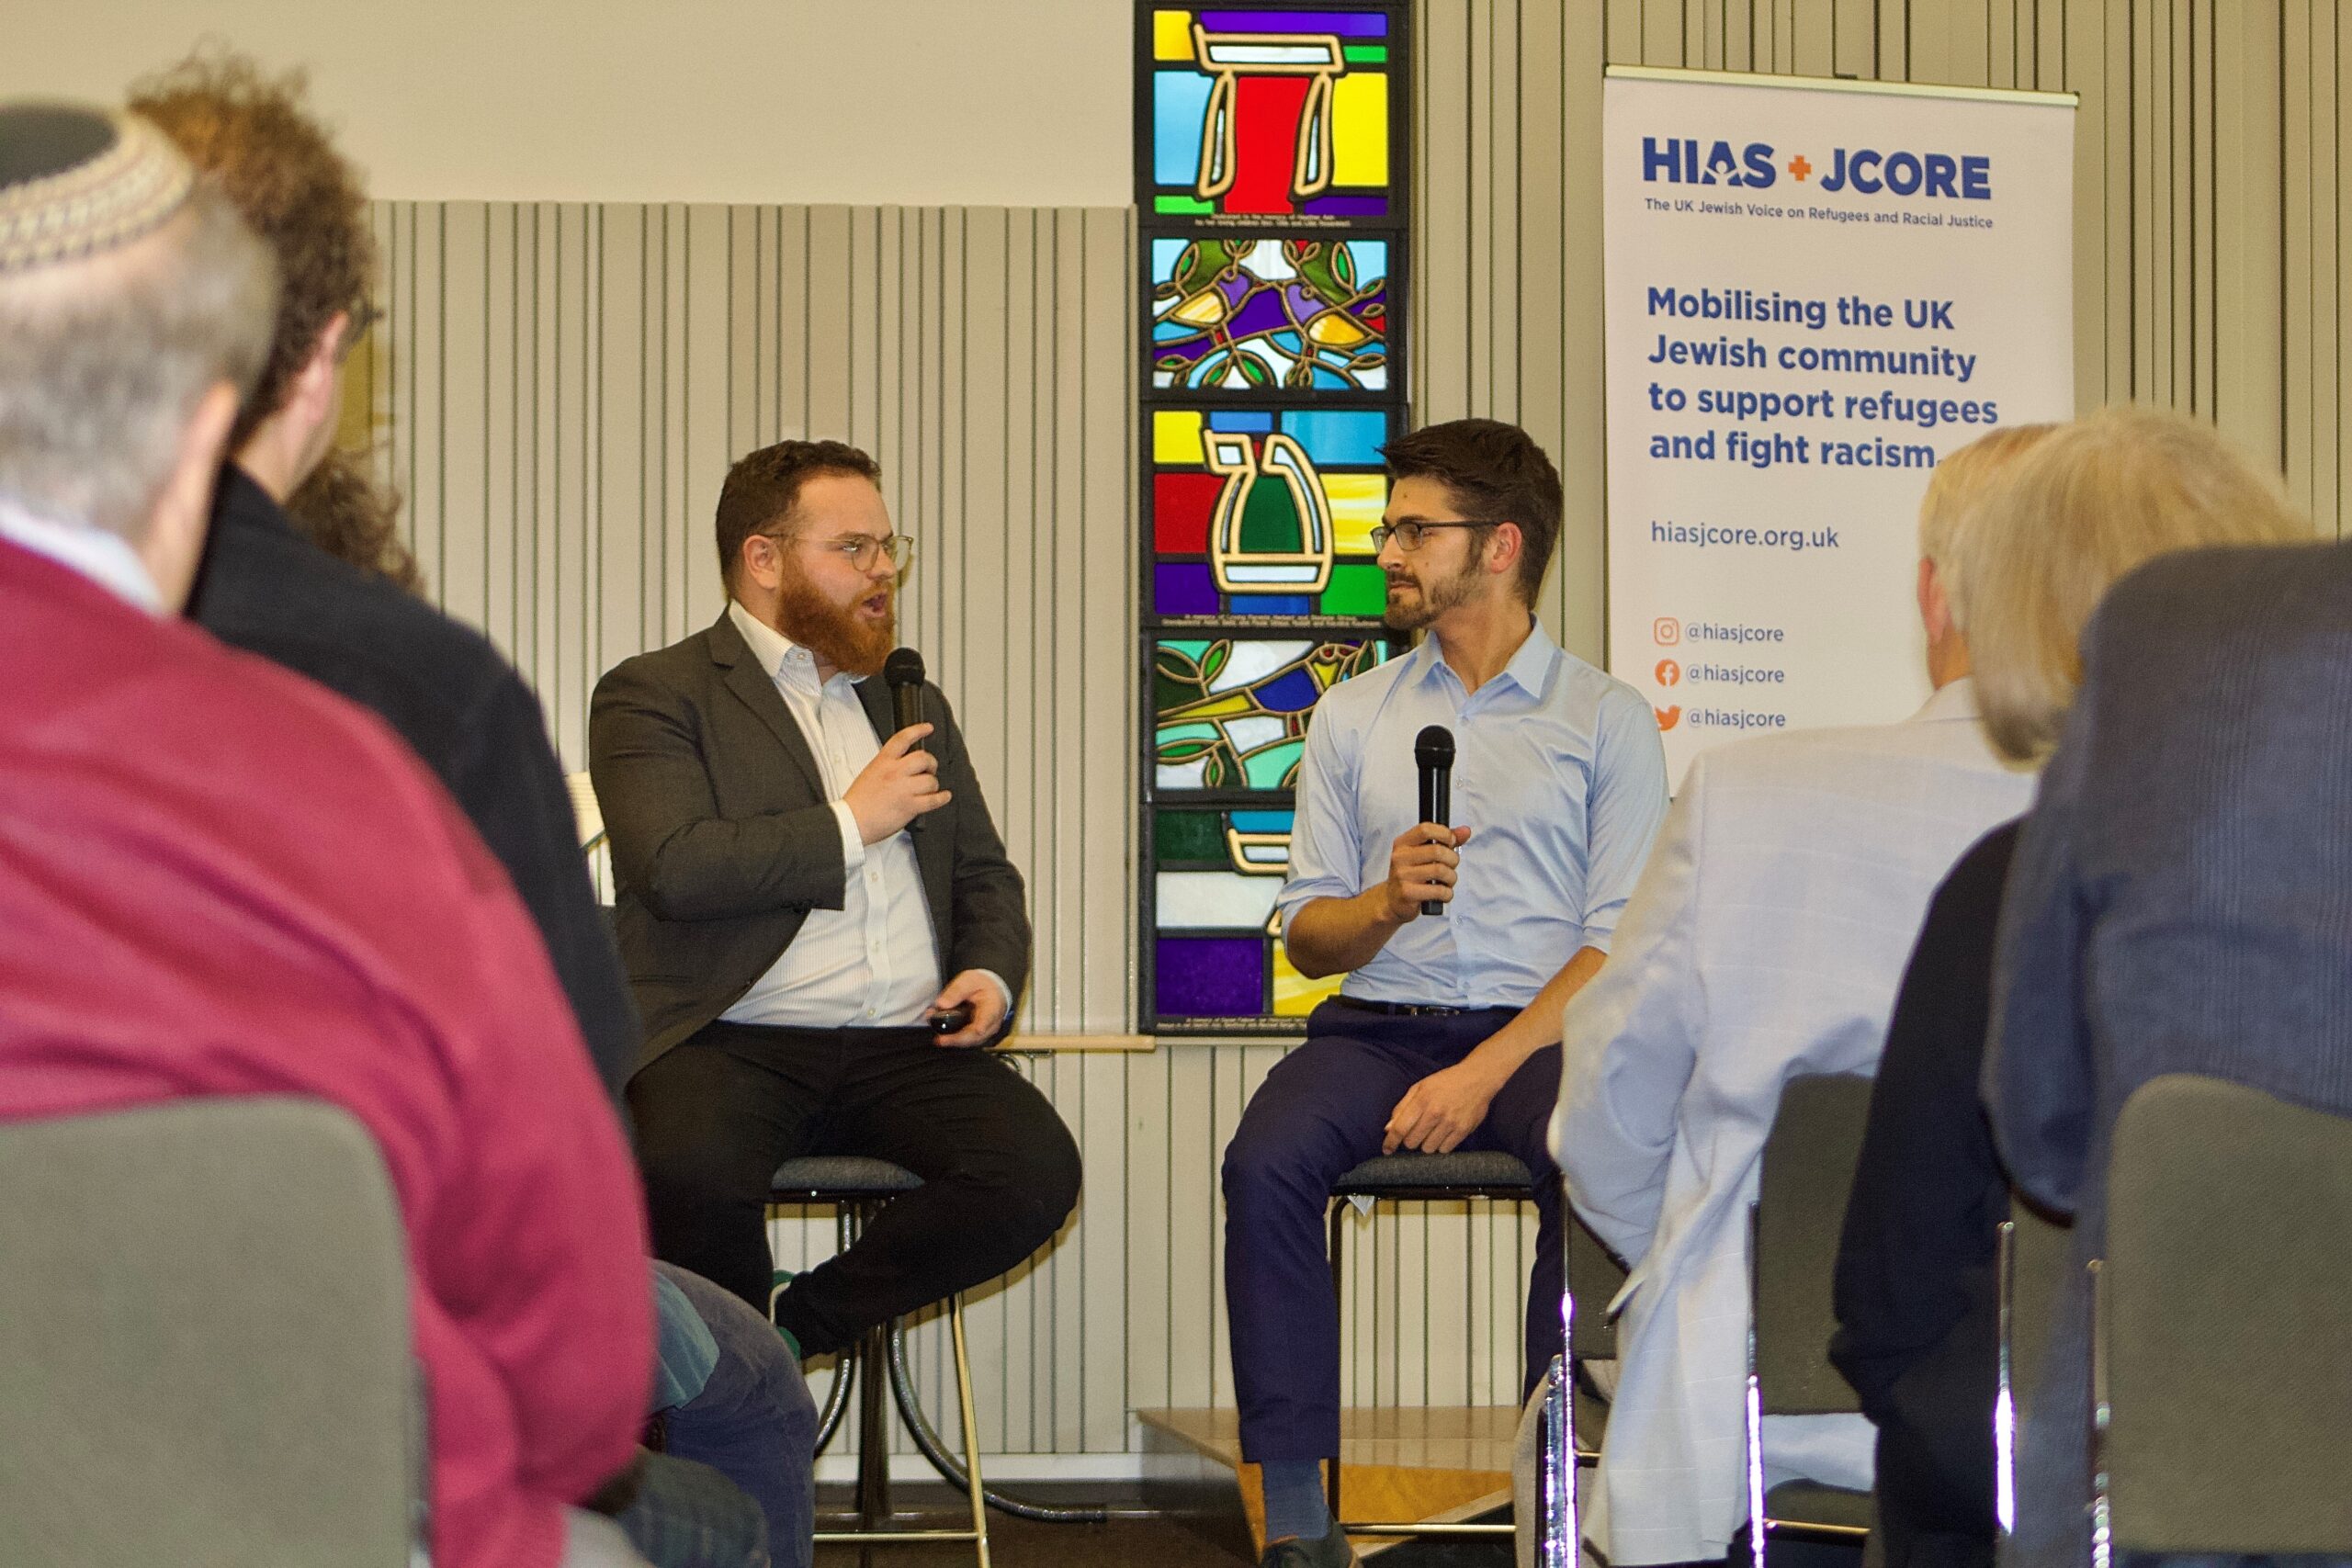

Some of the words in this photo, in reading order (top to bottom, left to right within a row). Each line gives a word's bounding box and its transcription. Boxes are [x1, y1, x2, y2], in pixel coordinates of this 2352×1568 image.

[1642, 136, 1777, 189] HIAS
[1819, 148, 1992, 200] JCORE
[1644, 197, 1671, 211] The
[1674, 199, 1694, 212] UK
[1698, 200, 1744, 215] Jewish
[1746, 203, 1783, 218] Voice
[1787, 208, 1805, 219] on
[1808, 206, 1871, 224] Refugees
[1873, 210, 1899, 224] and
[1902, 211, 1943, 226] Racial
[1947, 214, 1994, 229] Justice
[1647, 287, 1826, 331] Mobilising
[1837, 295, 1894, 328] the
[1904, 299, 1955, 331] UK
[1647, 333, 1767, 368] Jewish
[1777, 345, 1977, 383] community
[1647, 381, 1687, 412] to
[1697, 389, 1835, 423] support
[1845, 389, 1998, 429] refugees
[1649, 429, 1715, 460] and
[1725, 430, 1810, 469] fight
[1651, 520, 1839, 551] hiasjcore.org.uk
[1686, 622, 1784, 645] @hiasjcore
[1686, 663, 1785, 685] @hiasjcore
[1687, 708, 1787, 730] @hiasjcore
